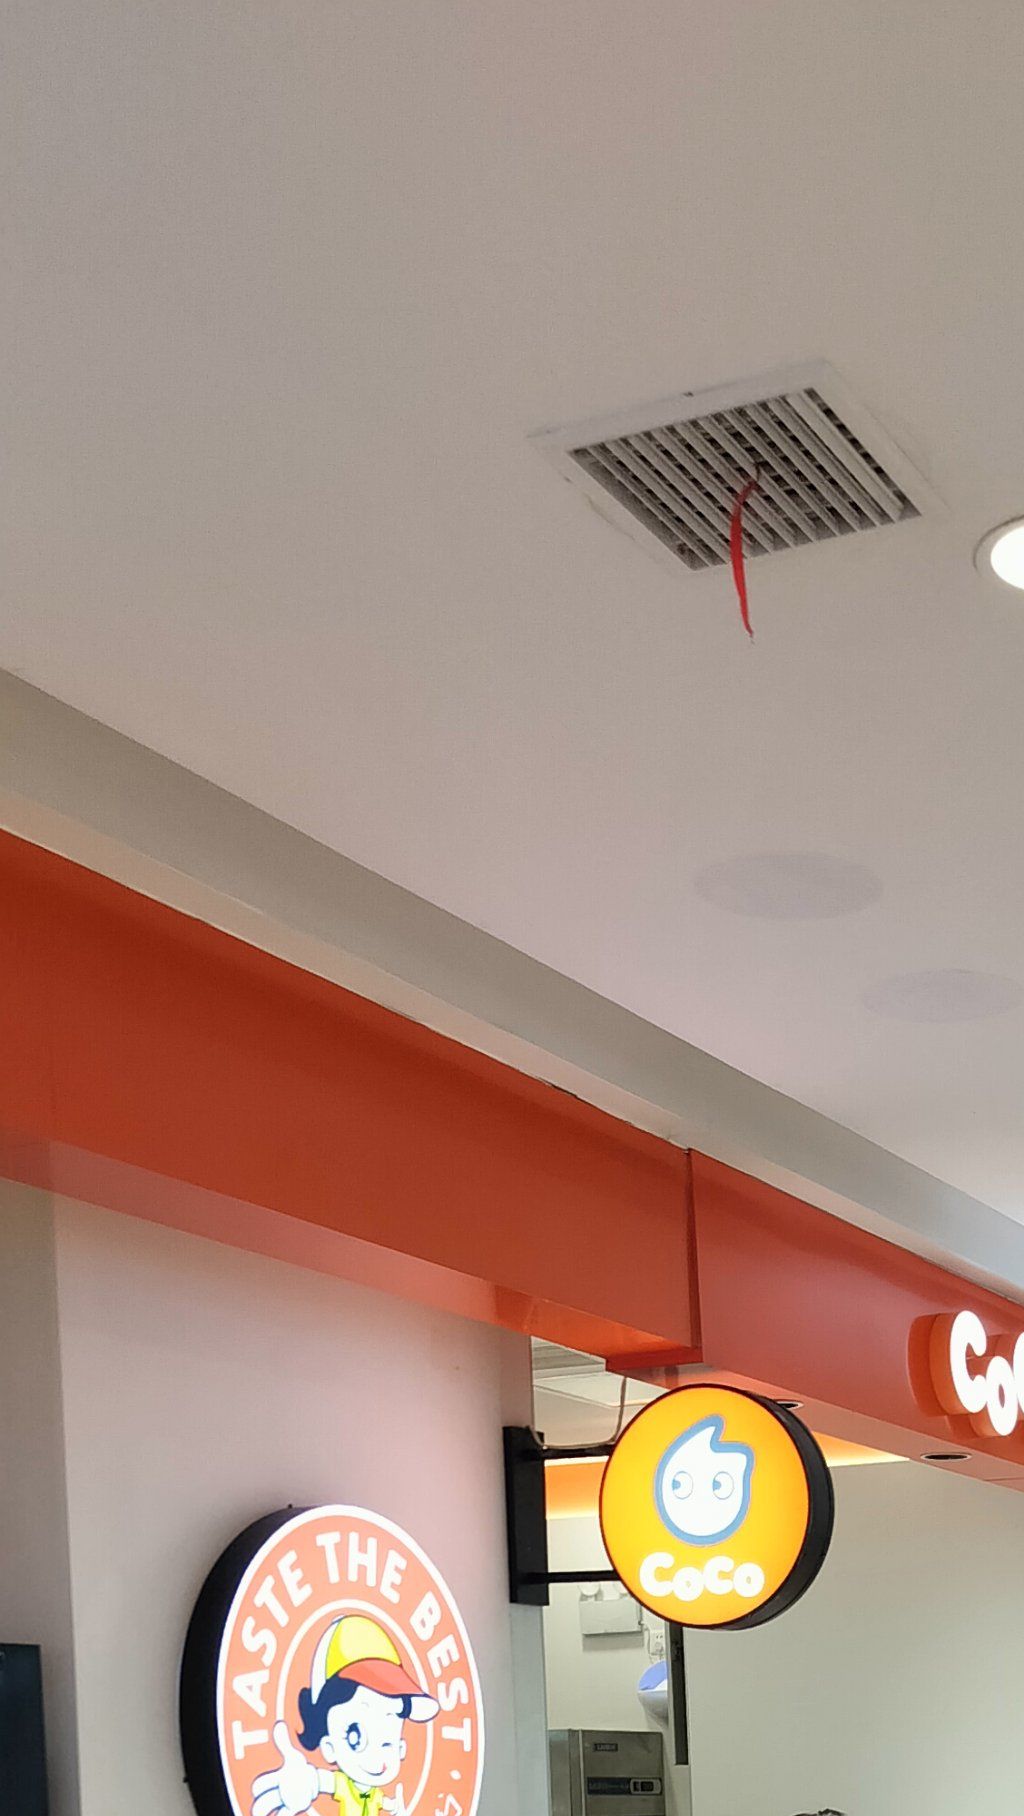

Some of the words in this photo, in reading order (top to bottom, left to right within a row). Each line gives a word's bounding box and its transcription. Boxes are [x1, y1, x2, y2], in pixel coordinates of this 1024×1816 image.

[232, 1550, 313, 1760] TASTE
[315, 1531, 408, 1604] THE
[409, 1591, 472, 1752] BEST
[639, 1552, 765, 1601] CoCo
